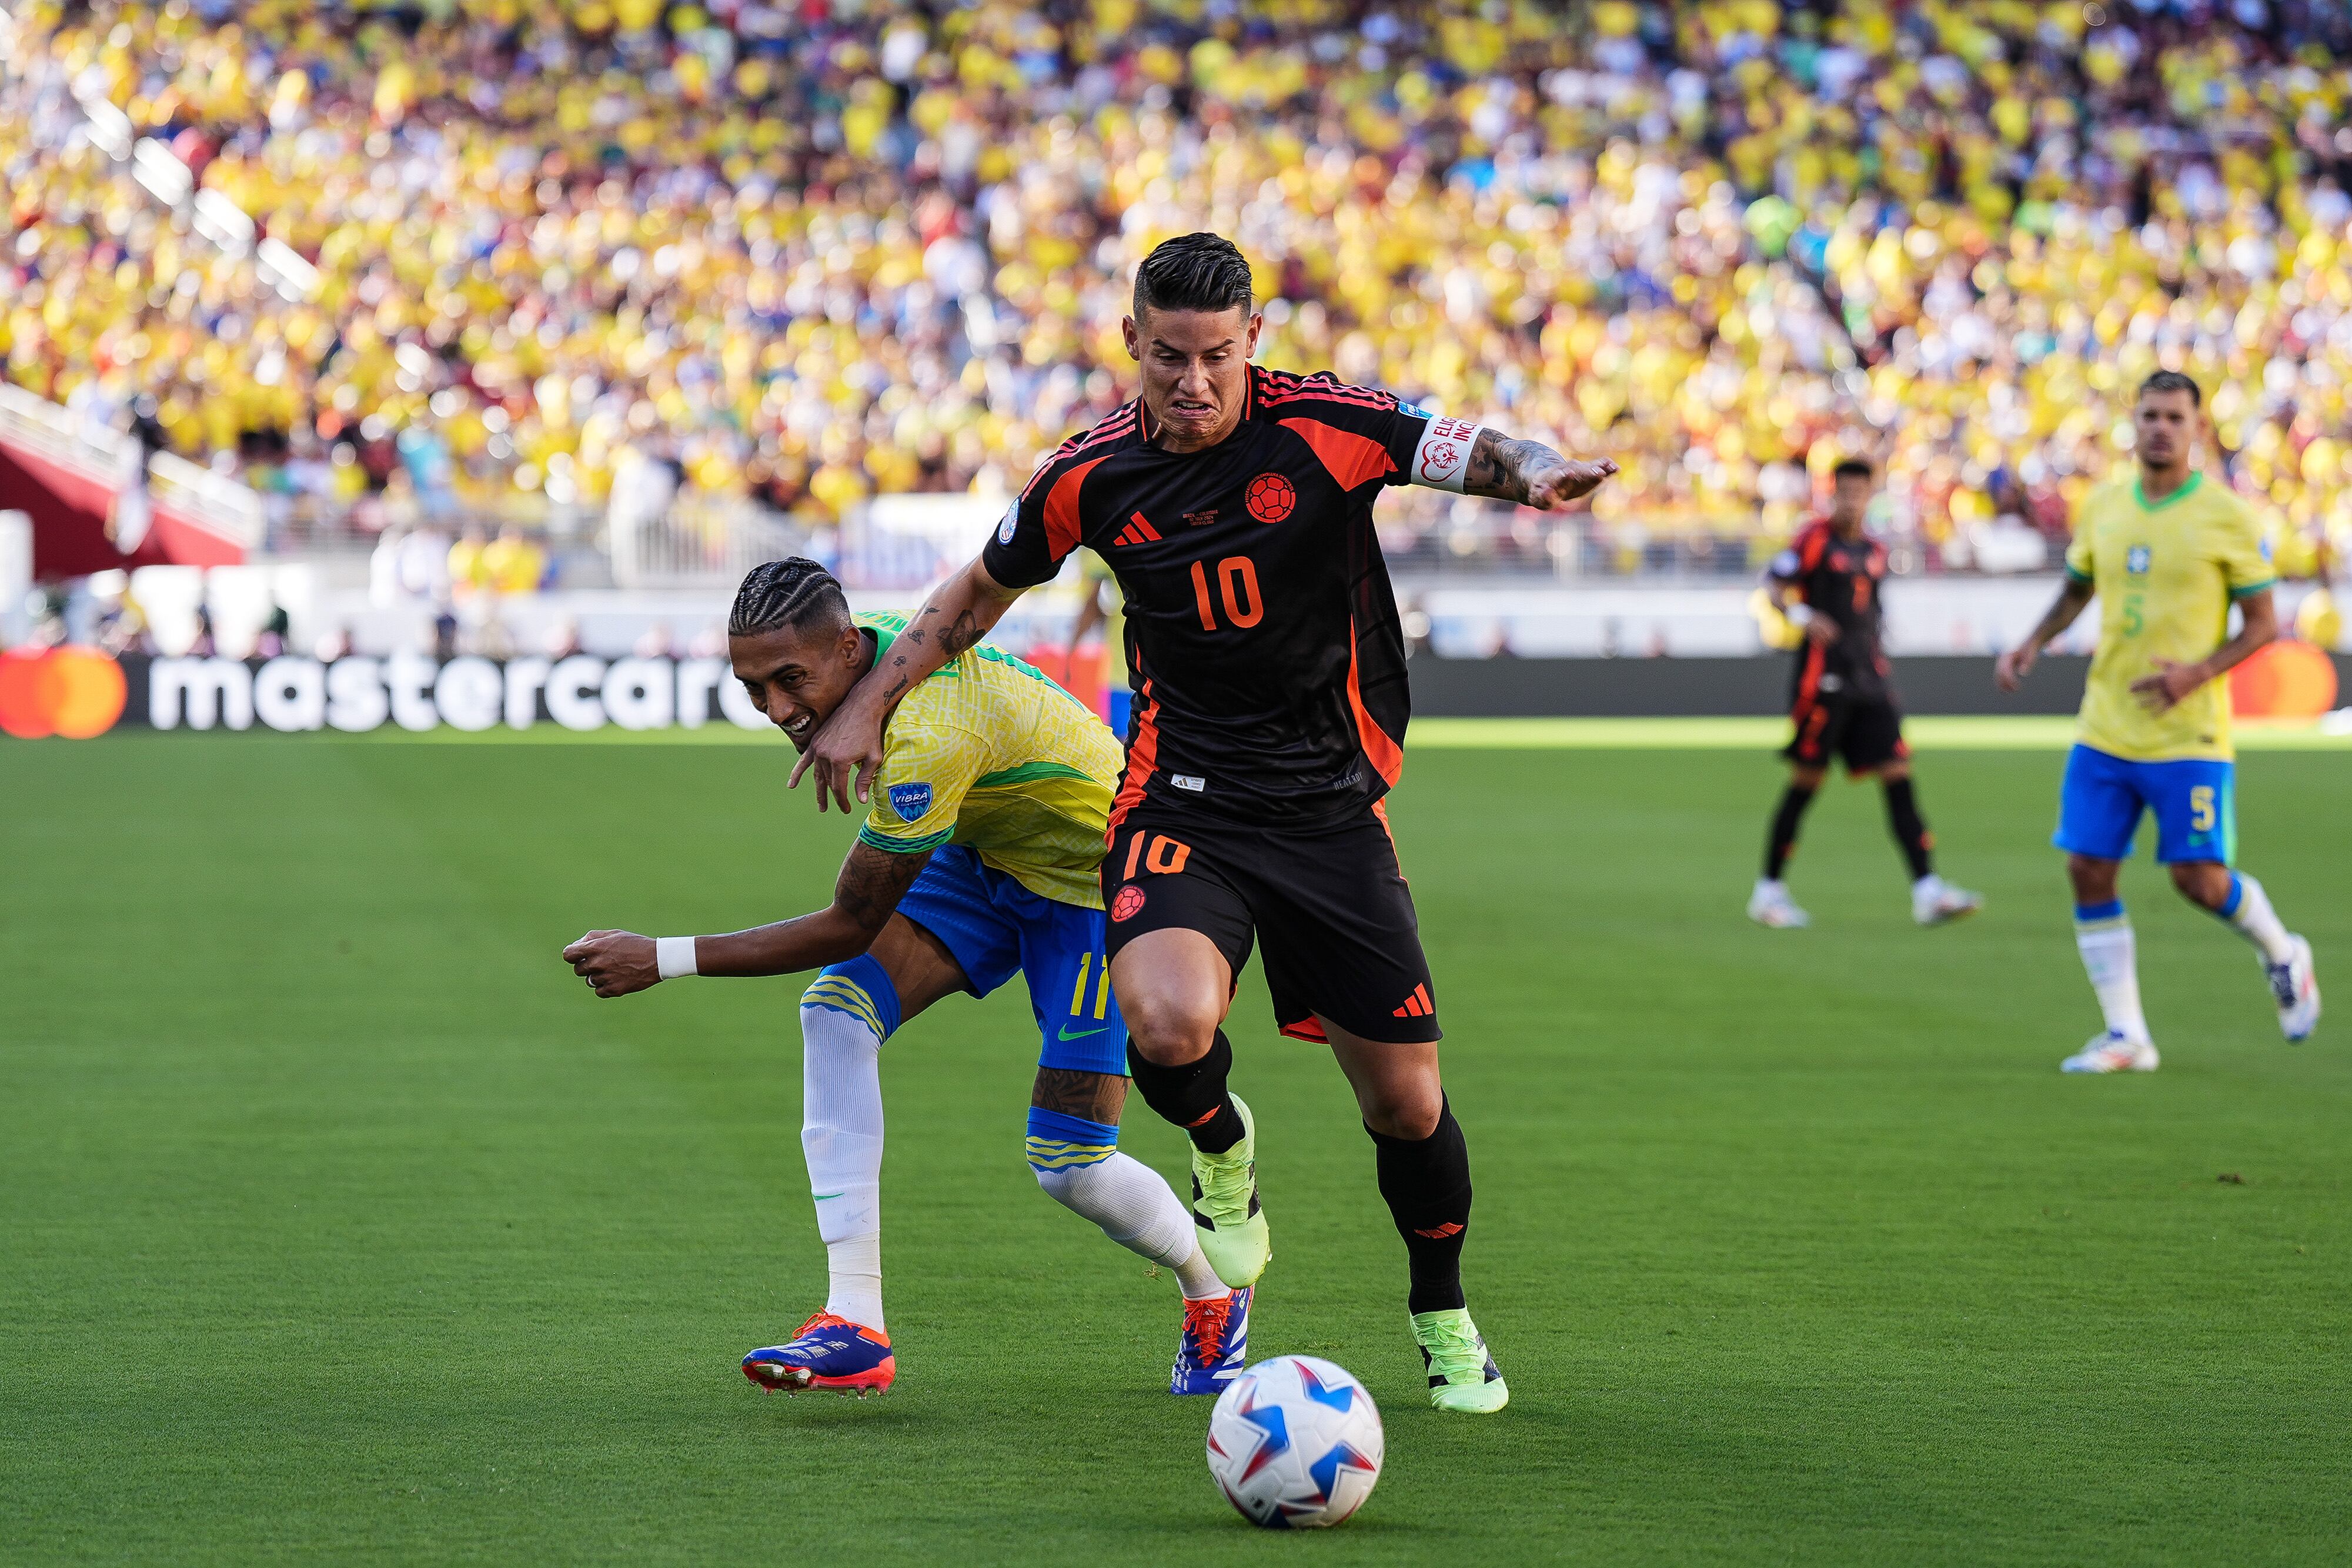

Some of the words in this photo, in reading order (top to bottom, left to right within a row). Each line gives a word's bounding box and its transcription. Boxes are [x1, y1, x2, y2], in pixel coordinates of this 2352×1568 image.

[1191, 556, 1264, 630] 10
[2123, 593, 2145, 638] 5
[896, 792, 927, 803] VIBRA
[2190, 785, 2216, 832] 5
[1123, 830, 1191, 881] 10
[1070, 952, 1110, 1019] 11
